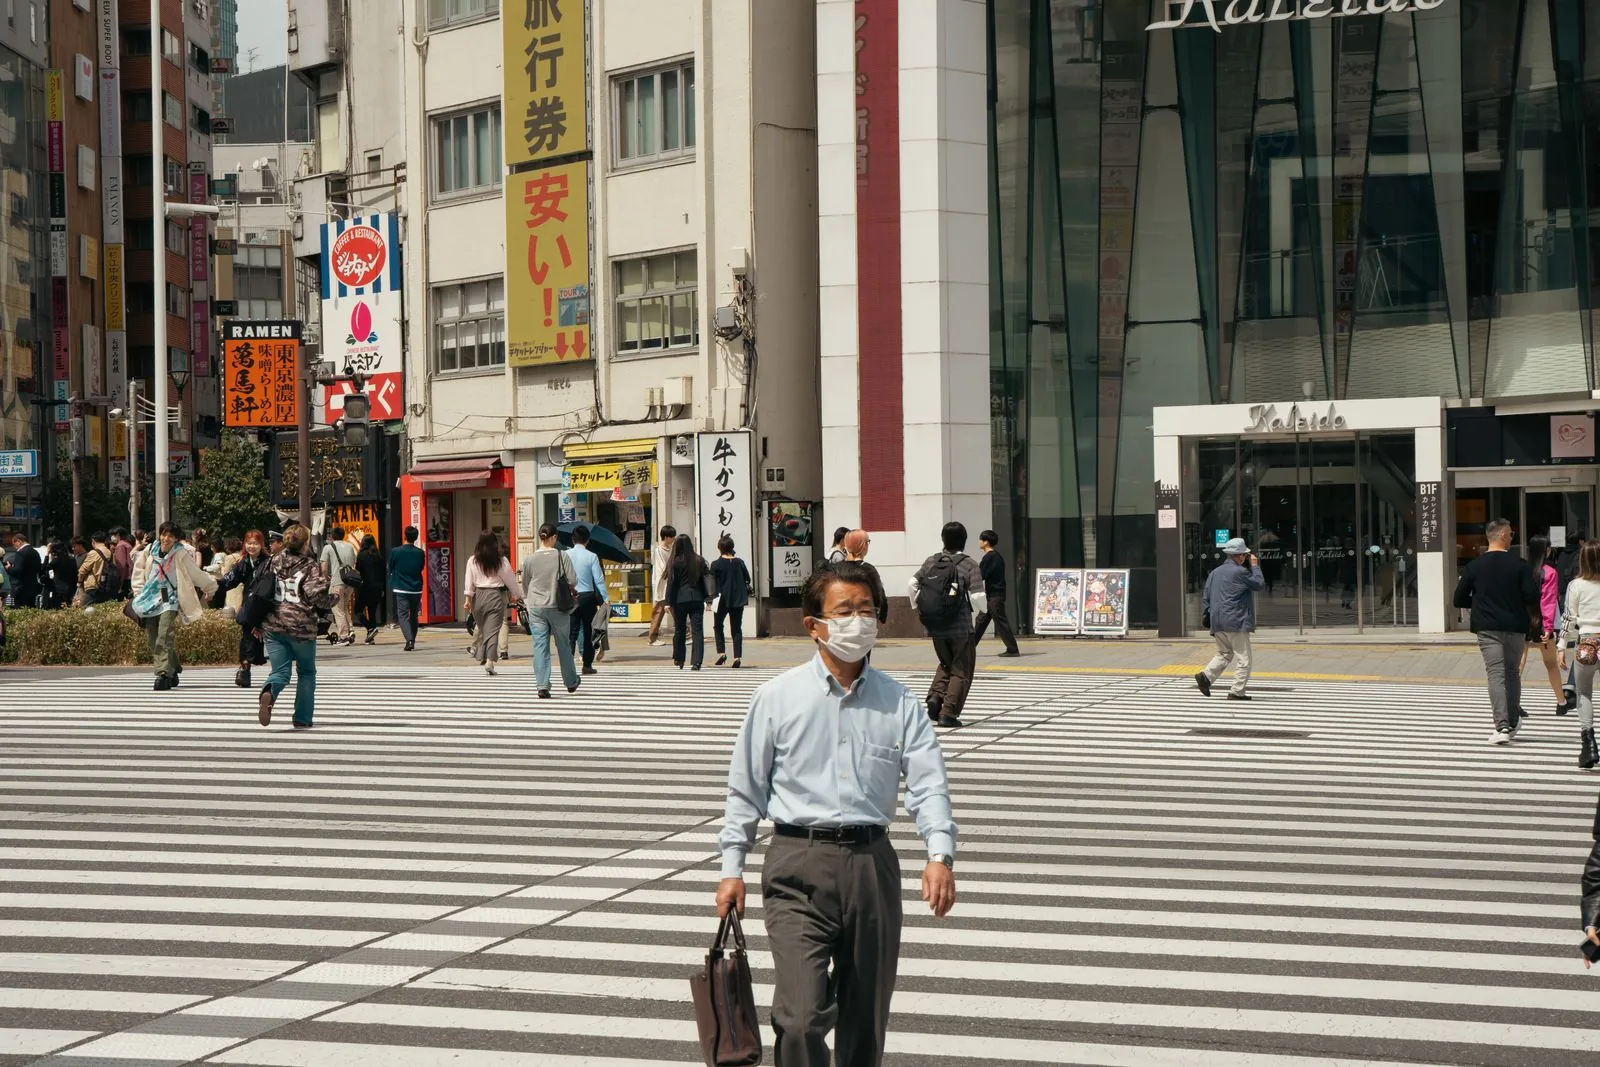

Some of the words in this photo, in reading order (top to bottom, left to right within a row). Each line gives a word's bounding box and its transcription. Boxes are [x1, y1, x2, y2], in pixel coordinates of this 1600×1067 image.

[104, 44, 112, 66] BODY
[334, 234, 350, 254] COFFEE
[355, 228, 384, 248] RESTAURANT
[336, 250, 381, 284] ジョナサン
[232, 326, 293, 338] RAMEN
[342, 352, 382, 373] バーミヤン
[230, 342, 259, 422] 萬馬軒
[258, 343, 272, 422] 味噌らーめん
[275, 345, 295, 422] 東京濃厚
[1244, 402, 1348, 432] Kaleido
[622, 466, 651, 487] 金券
[1420, 484, 1437, 495] B1F
[332, 503, 379, 523] RAMEN
[440, 547, 450, 588] Device
